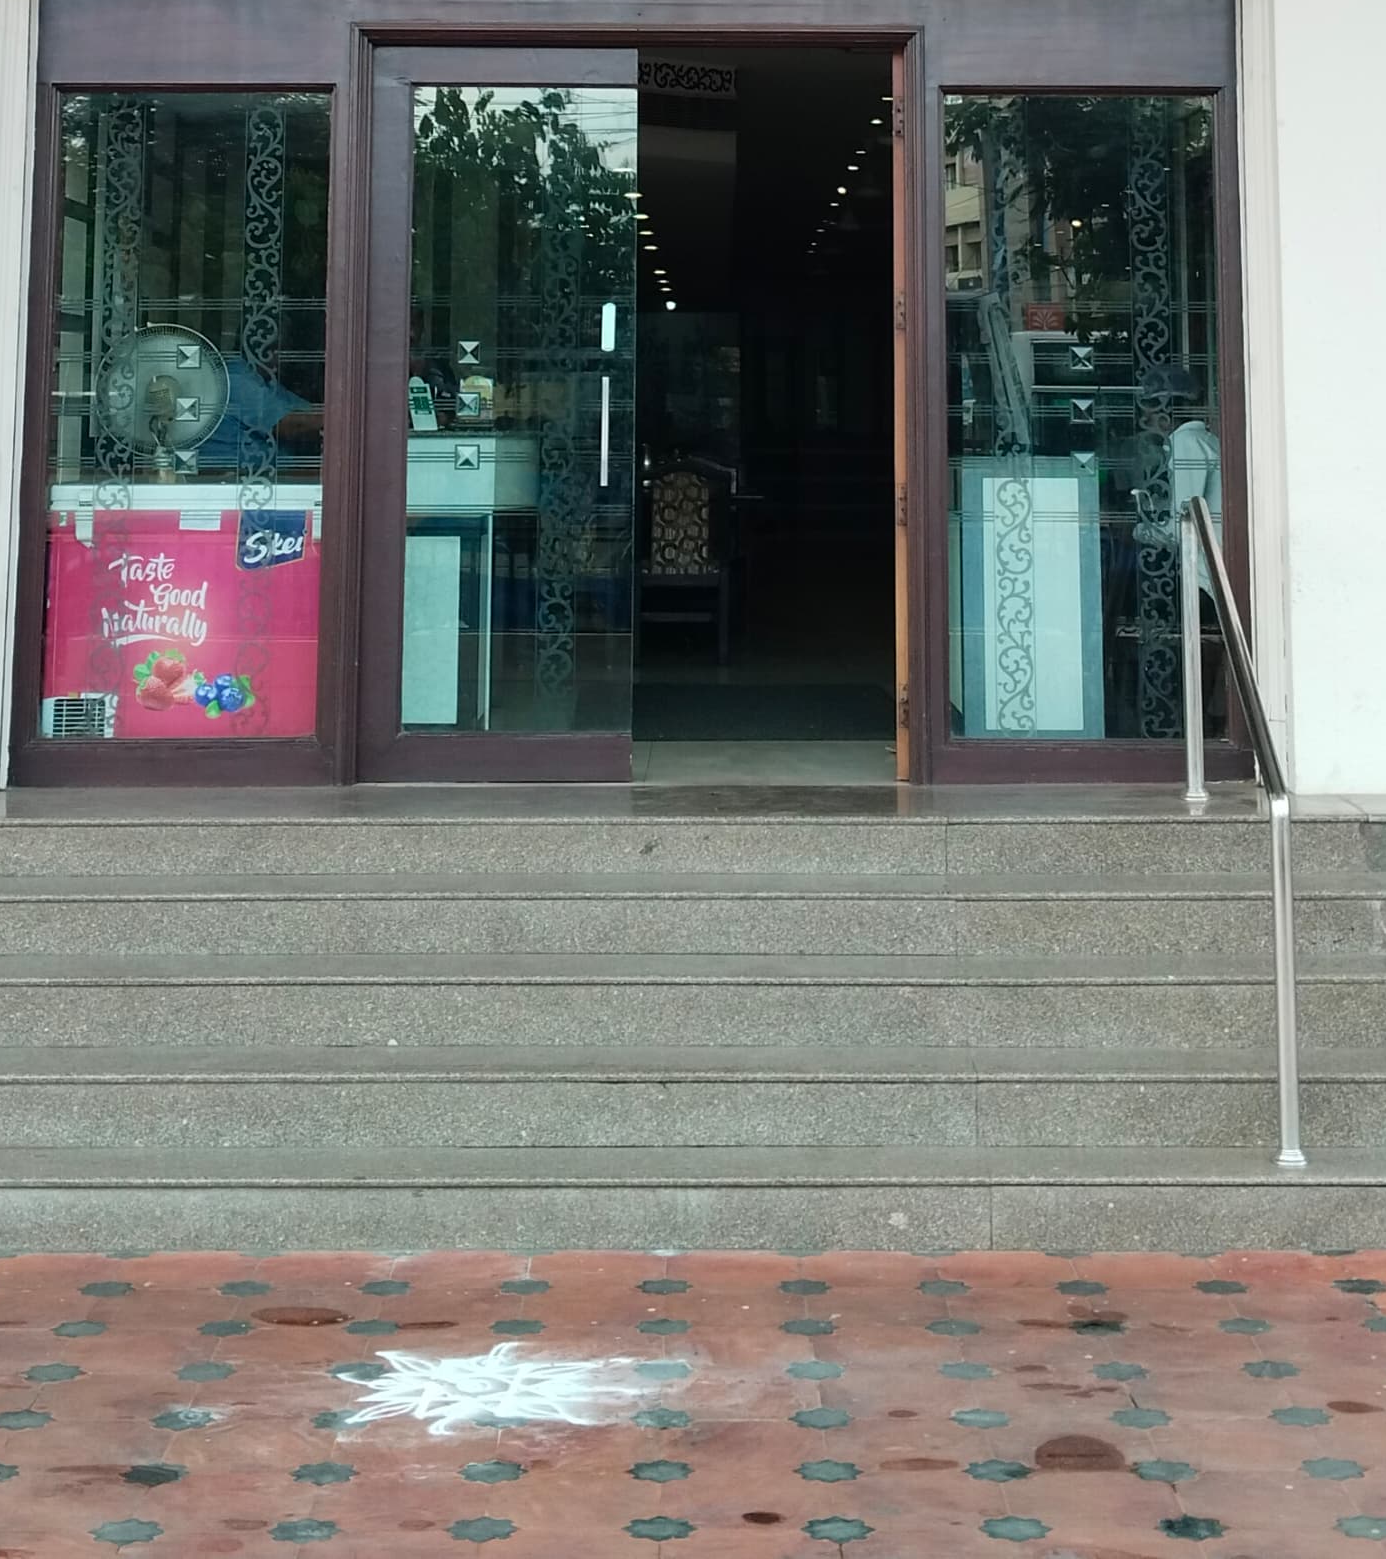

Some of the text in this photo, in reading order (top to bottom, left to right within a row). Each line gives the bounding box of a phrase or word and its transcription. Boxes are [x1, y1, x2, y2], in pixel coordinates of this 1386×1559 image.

[107, 552, 176, 588] Taste
[149, 580, 208, 612] Good
[101, 599, 207, 646] Naturally
